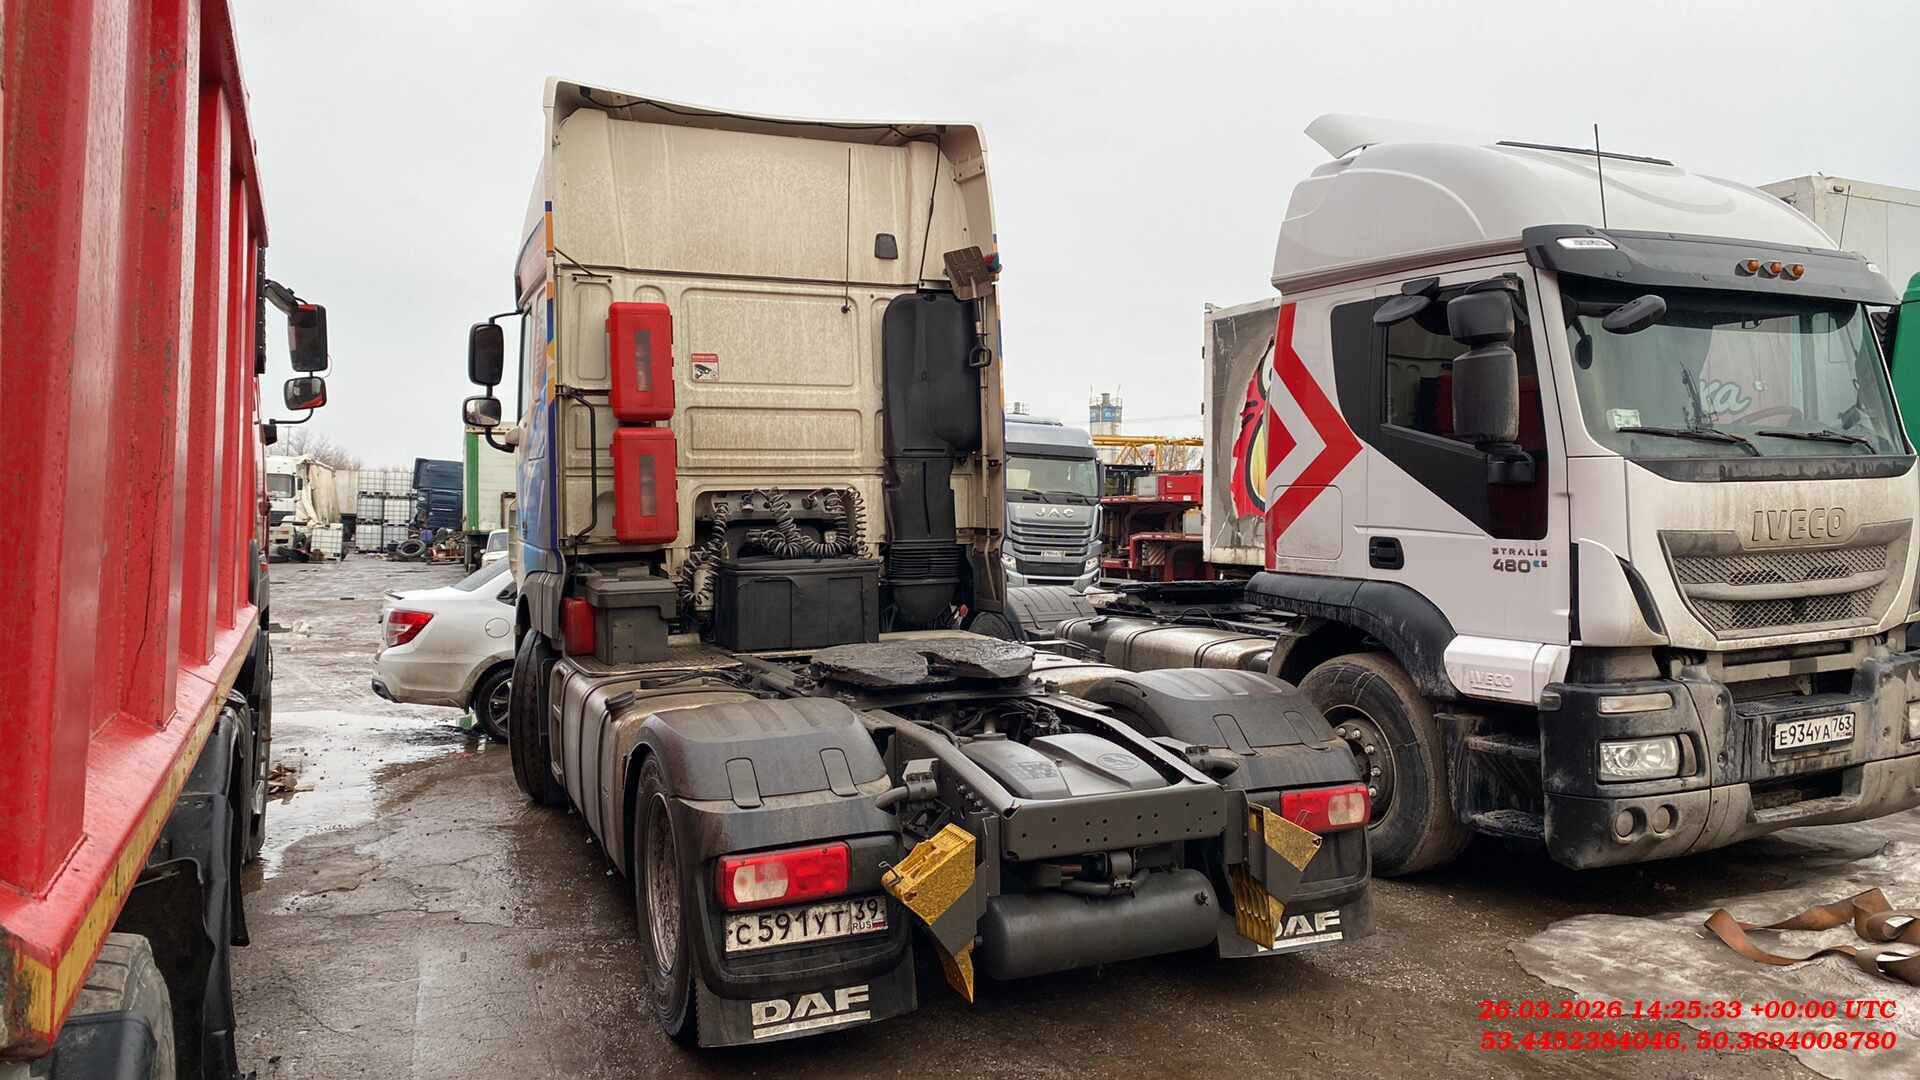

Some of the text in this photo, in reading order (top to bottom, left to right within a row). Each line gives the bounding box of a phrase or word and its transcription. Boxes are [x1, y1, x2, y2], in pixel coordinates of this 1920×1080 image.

[1035, 507, 1075, 519] JAC
[1751, 507, 1846, 541] IVECO
[1492, 547, 1548, 556] STRALIS
[1493, 559, 1531, 573] 480
[1469, 671, 1514, 688] IVECO
[1832, 715, 1852, 733] 763
[854, 899, 879, 922] 39
[852, 920, 872, 932] RUS
[751, 984, 870, 1026] DAF
